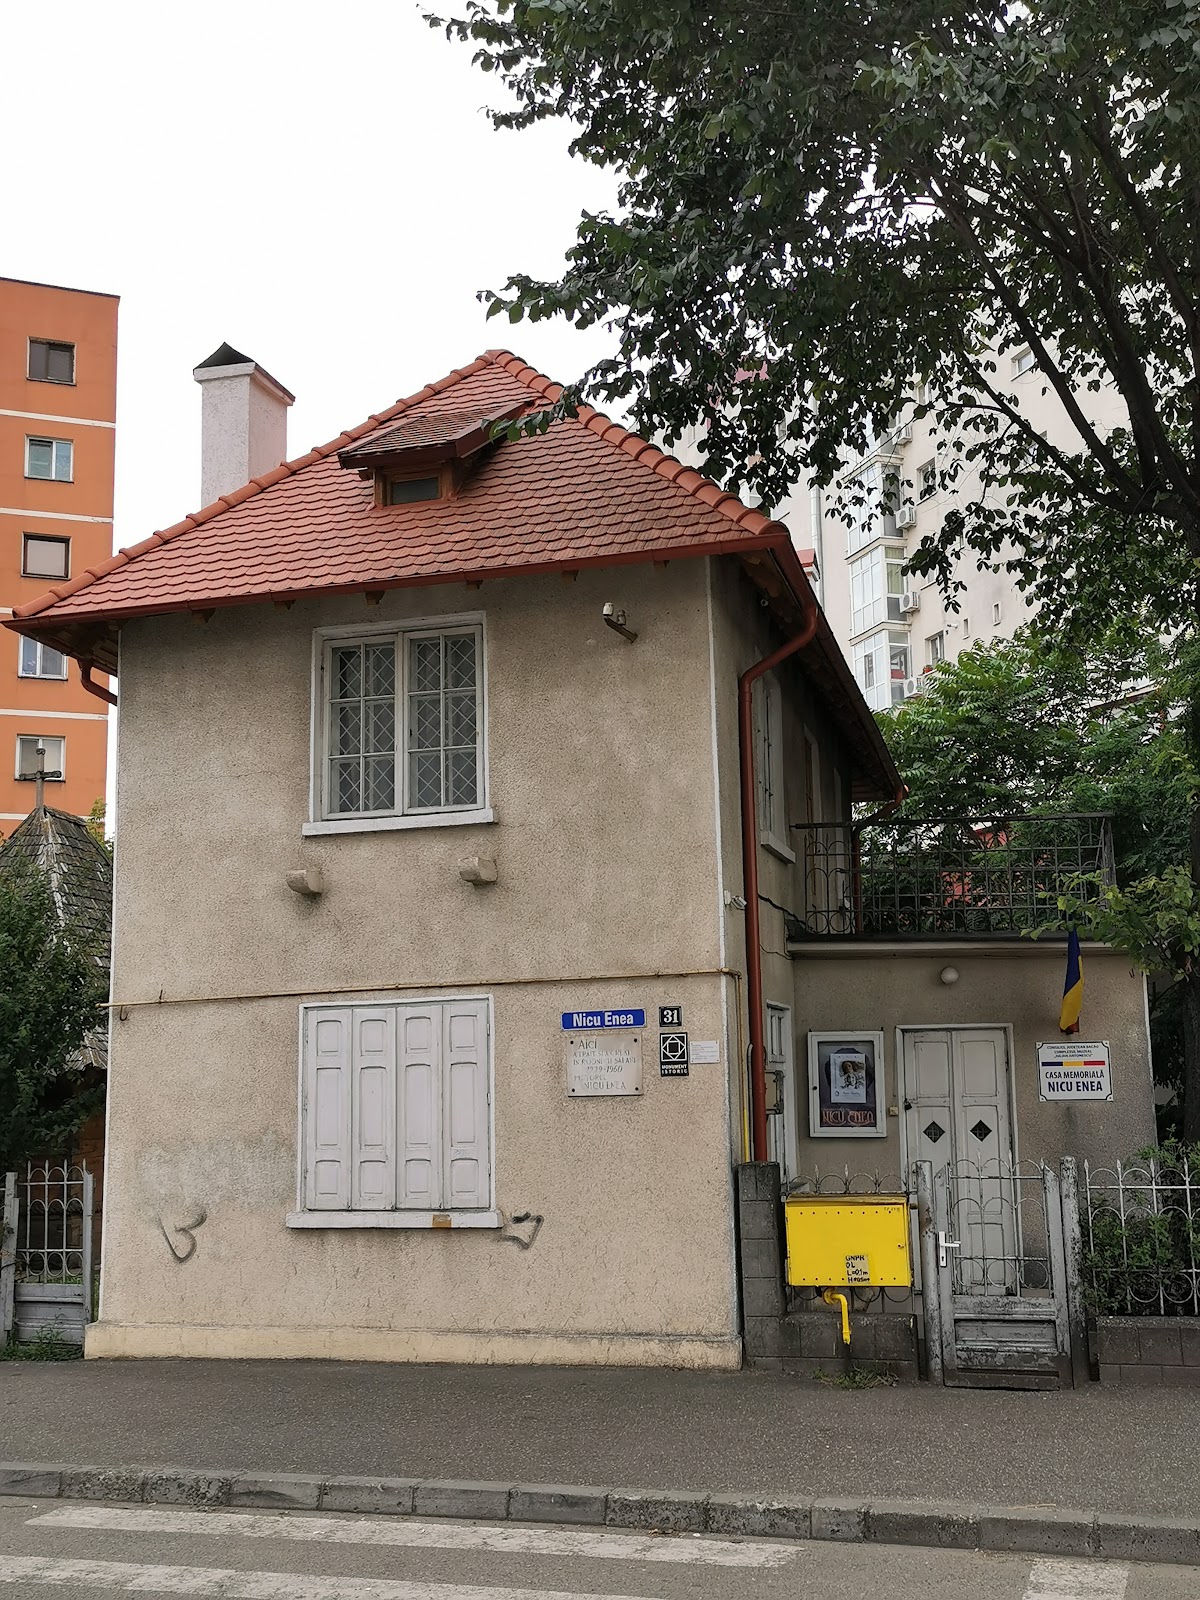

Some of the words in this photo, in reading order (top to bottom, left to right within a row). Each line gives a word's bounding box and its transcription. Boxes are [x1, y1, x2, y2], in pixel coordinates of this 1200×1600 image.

[573, 1013, 601, 1027] Nicu
[605, 1011, 634, 1026] Enea
[663, 1009, 679, 1023] 31
[1045, 1071, 1062, 1079] CASA
[1063, 1069, 1105, 1078] MEMORIALĂ
[1048, 1081, 1073, 1092] NICU
[1075, 1081, 1103, 1092] ENEA
